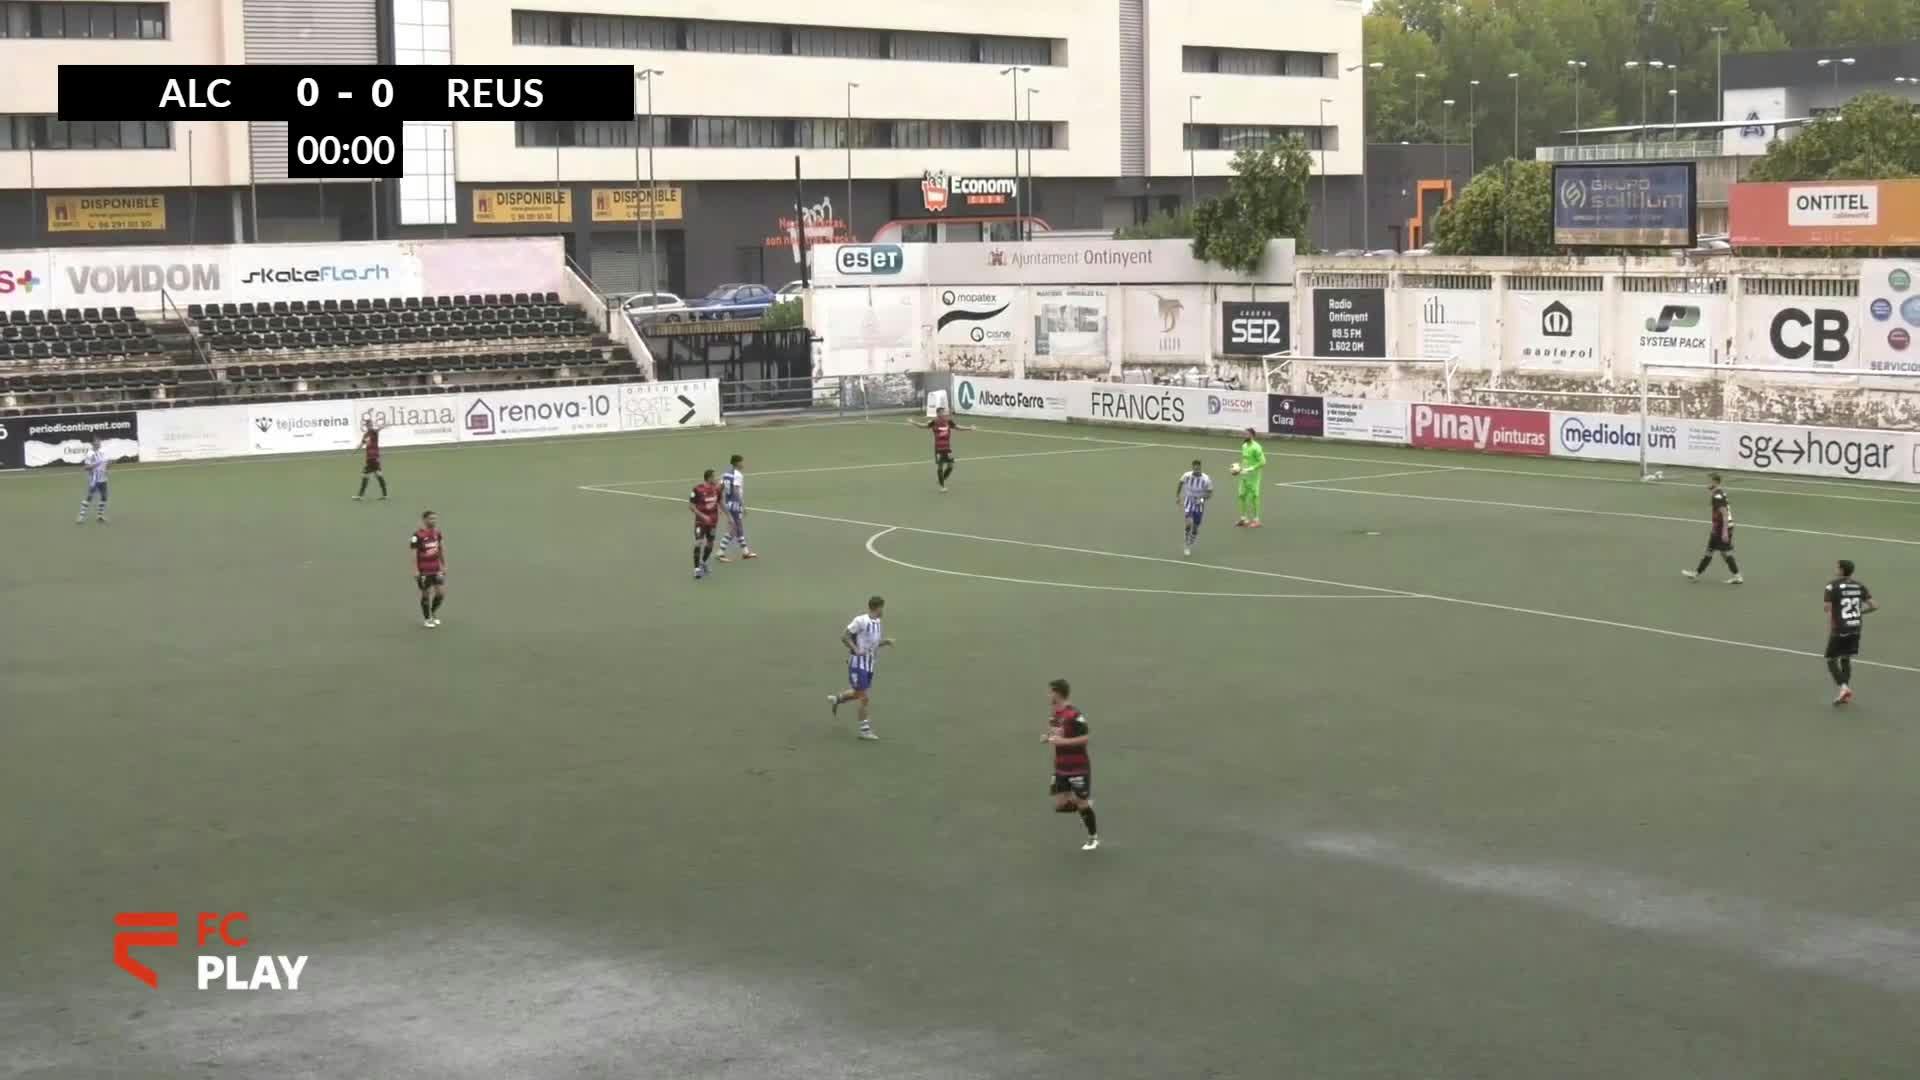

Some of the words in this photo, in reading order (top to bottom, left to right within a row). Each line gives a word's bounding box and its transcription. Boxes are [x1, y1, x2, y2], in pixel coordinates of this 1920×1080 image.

[951, 176, 1017, 197] Economy
[81, 198, 160, 209] DISPONIBLE
[497, 192, 565, 205] DISPONIBLE
[614, 190, 676, 203] DISPONIBLE
[1796, 194, 1869, 210] ONTITEL
[1012, 252, 1079, 267] Ajuntament
[1084, 249, 1153, 267] Ontinyent
[67, 264, 220, 294] VONDOM
[957, 292, 997, 303] mopatex
[1329, 299, 1353, 310] Radio
[1329, 312, 1369, 325] Ontinyent
[986, 329, 1011, 339] cisne
[1232, 319, 1281, 344] SER
[1332, 329, 1349, 339] 89.5
[1351, 330, 1362, 339] FM
[1770, 308, 1850, 362] CB
[1640, 336, 1678, 348] SYSTEM
[1680, 338, 1706, 349] PACK
[979, 390, 1016, 407] Alberto
[1017, 392, 1044, 408] Ferre
[500, 395, 609, 422] renova-10
[1092, 391, 1184, 422] FRANCÉS
[277, 417, 349, 431] tejidosreina
[361, 406, 455, 432] galiana
[1272, 414, 1295, 426] Clara
[29, 421, 131, 435] periodicontinyent.com
[1416, 406, 1491, 449] Pinay
[1493, 427, 1546, 446] pinturas
[1651, 425, 1678, 434] BANCO
[1841, 597, 1861, 619] 23
